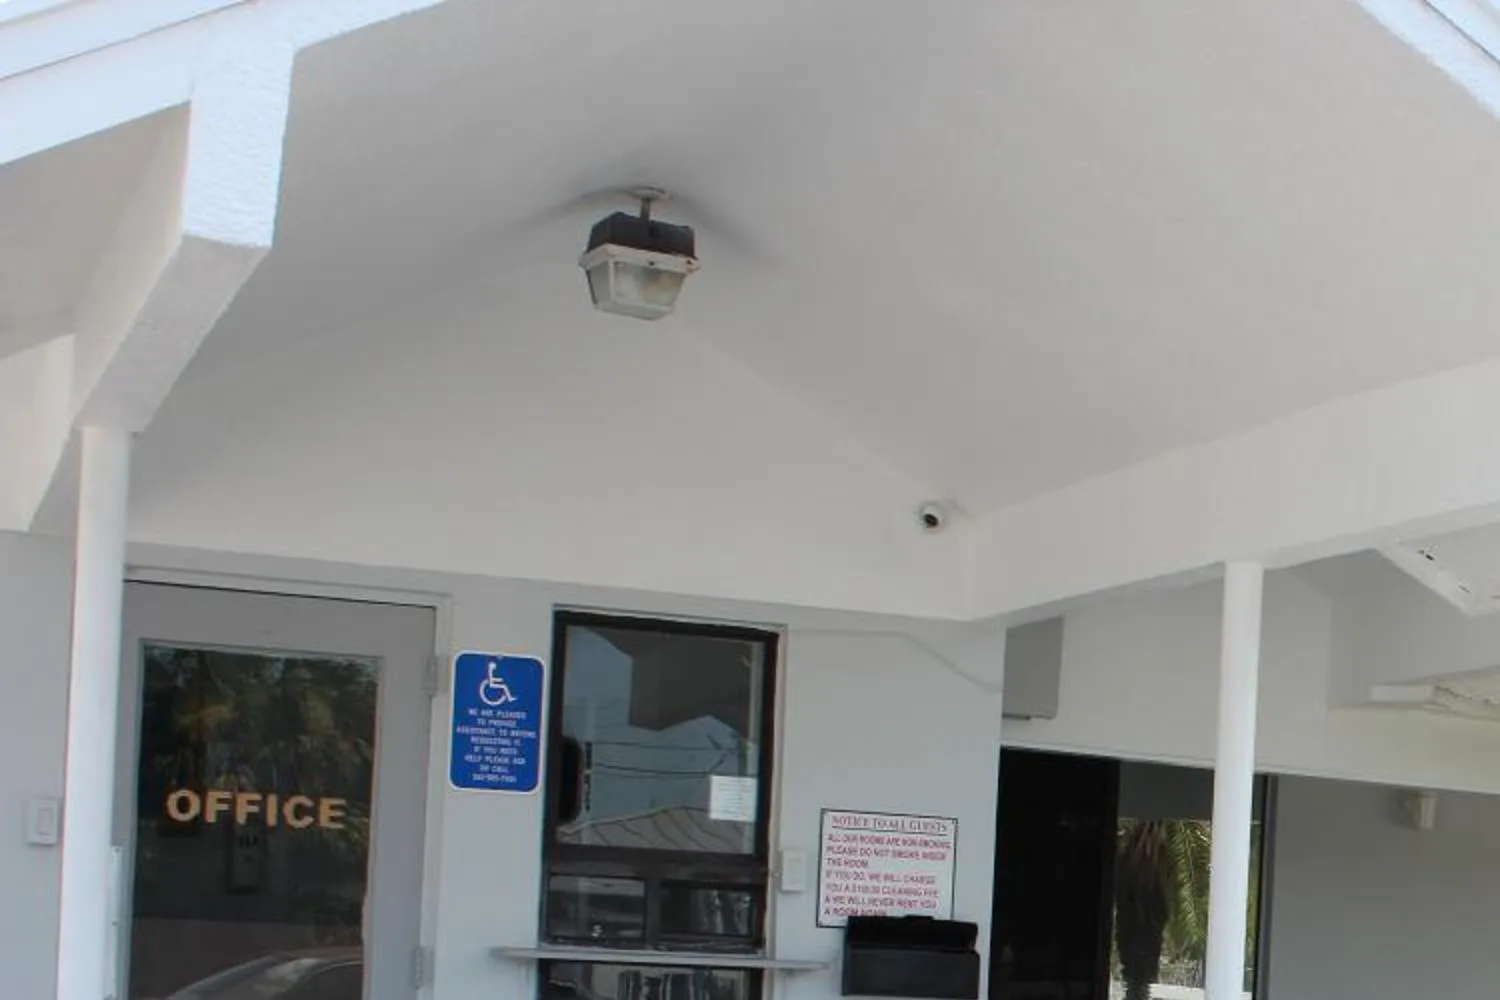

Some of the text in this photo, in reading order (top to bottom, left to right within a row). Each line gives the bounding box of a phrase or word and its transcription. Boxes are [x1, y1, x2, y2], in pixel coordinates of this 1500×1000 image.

[166, 788, 346, 829] OFFICE
[832, 816, 947, 830] NOTICE TO ALL GUESTS
[828, 834, 841, 842] ALL
[844, 835, 858, 843] OUR
[860, 835, 885, 844] ROOMS
[886, 837, 900, 846] ARE
[826, 846, 946, 860] PLEASE DO NOT SMOKE INSIDE
[827, 858, 841, 866] THE
[826, 870, 832, 878] IF
[835, 871, 850, 879] YOU
[869, 873, 881, 882] WE
[883, 873, 901, 882] WILL
[904, 875, 936, 884] CHARGE
[826, 884, 842, 893] YOU
[844, 885, 849, 893] A
[881, 886, 922, 896] CLEANING
[923, 888, 939, 897] FEE
[832, 896, 845, 904] WE
[847, 896, 865, 905] WILL
[868, 897, 895, 907] NEVER
[897, 899, 918, 908] RENT
[920, 900, 936, 909] YOU
[833, 907, 858, 916] ROOM
